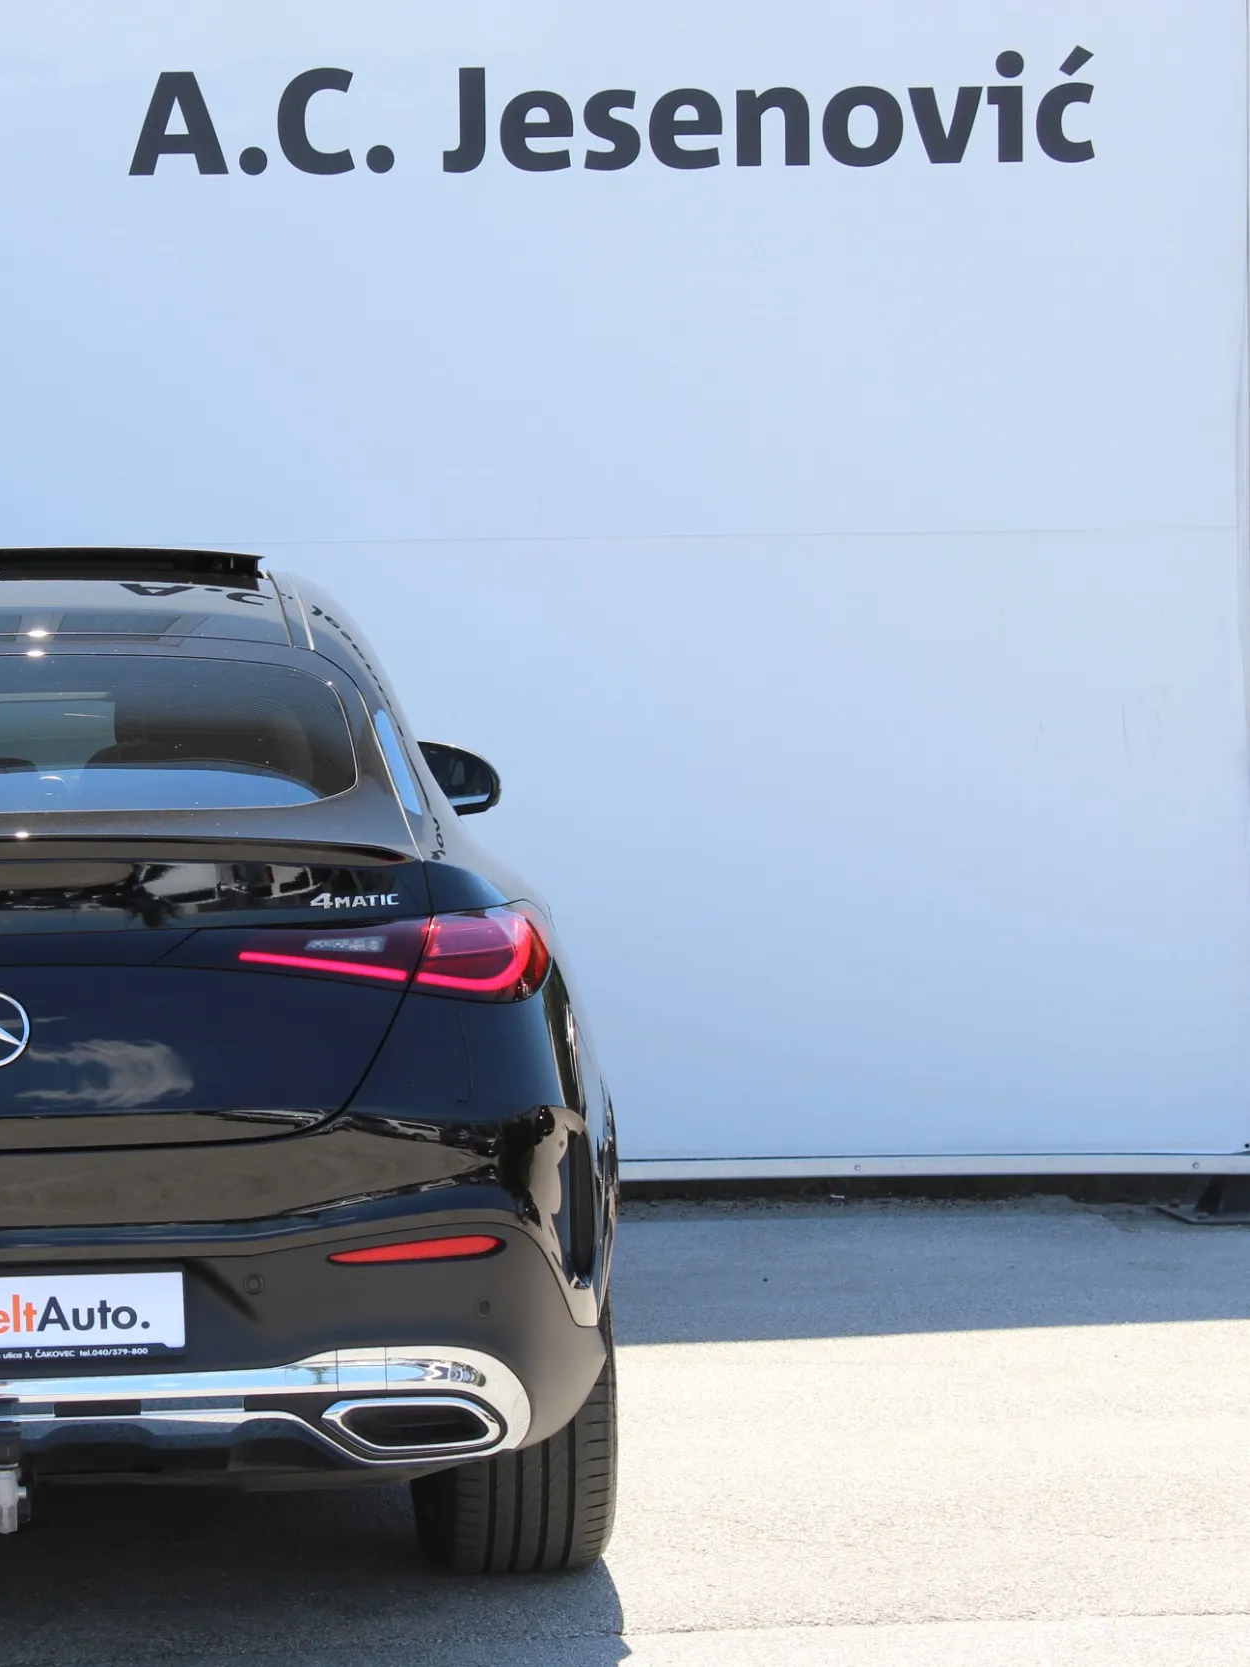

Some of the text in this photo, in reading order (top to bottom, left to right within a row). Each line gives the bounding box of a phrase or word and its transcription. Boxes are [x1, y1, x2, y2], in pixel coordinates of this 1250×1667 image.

[128, 45, 1096, 176] A.C. Jesenović
[310, 892, 401, 910] 4MATIC
[2, 1352, 23, 1360] ulica
[35, 1349, 76, 1359] ČAKOVEC
